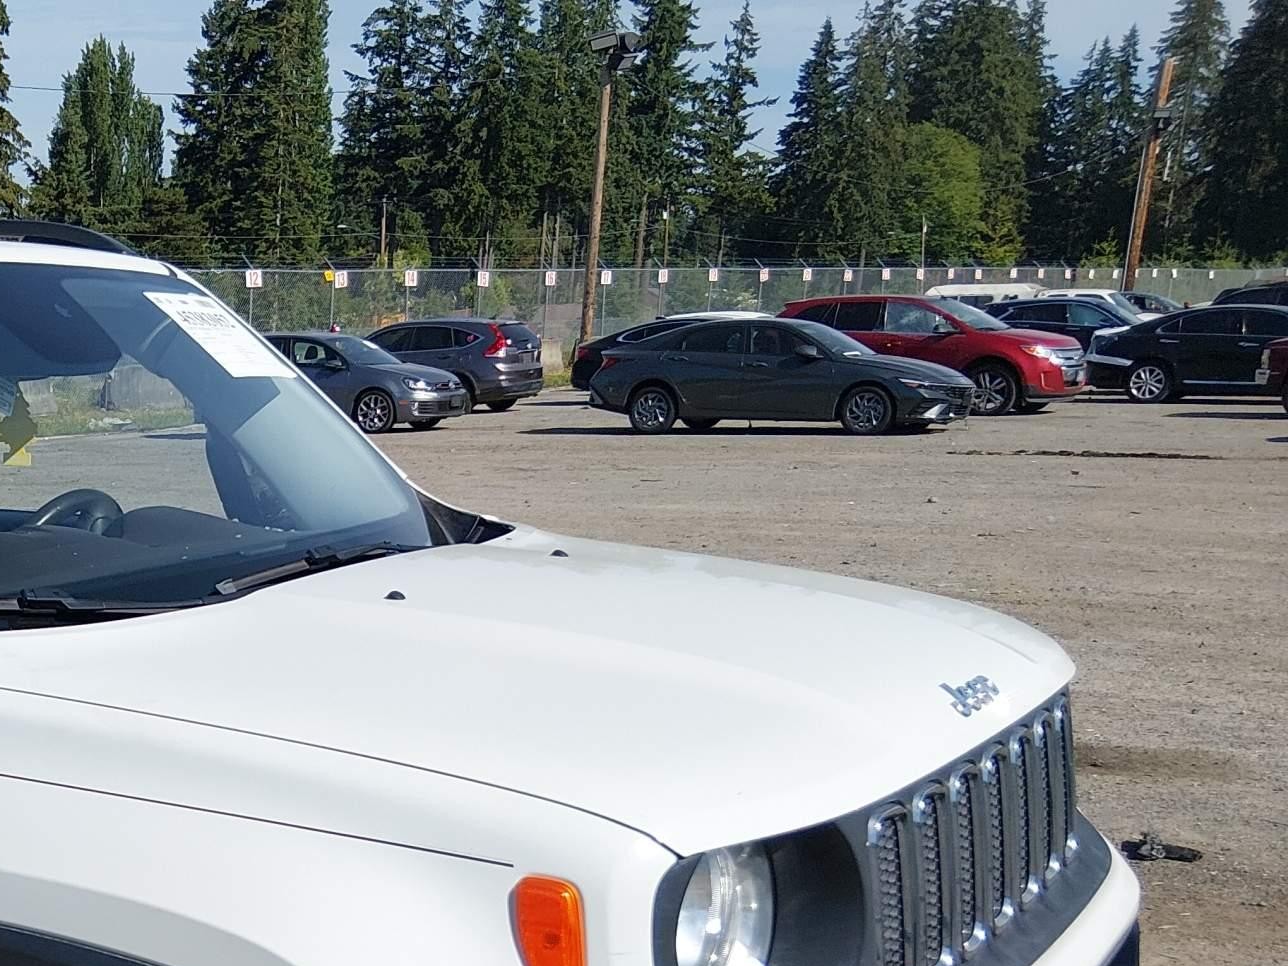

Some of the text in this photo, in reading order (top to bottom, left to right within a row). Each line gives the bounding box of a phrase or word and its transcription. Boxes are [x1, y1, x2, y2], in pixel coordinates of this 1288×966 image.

[249, 271, 259, 286] 12
[337, 272, 345, 287] 13
[938, 675, 999, 717] Jeep
